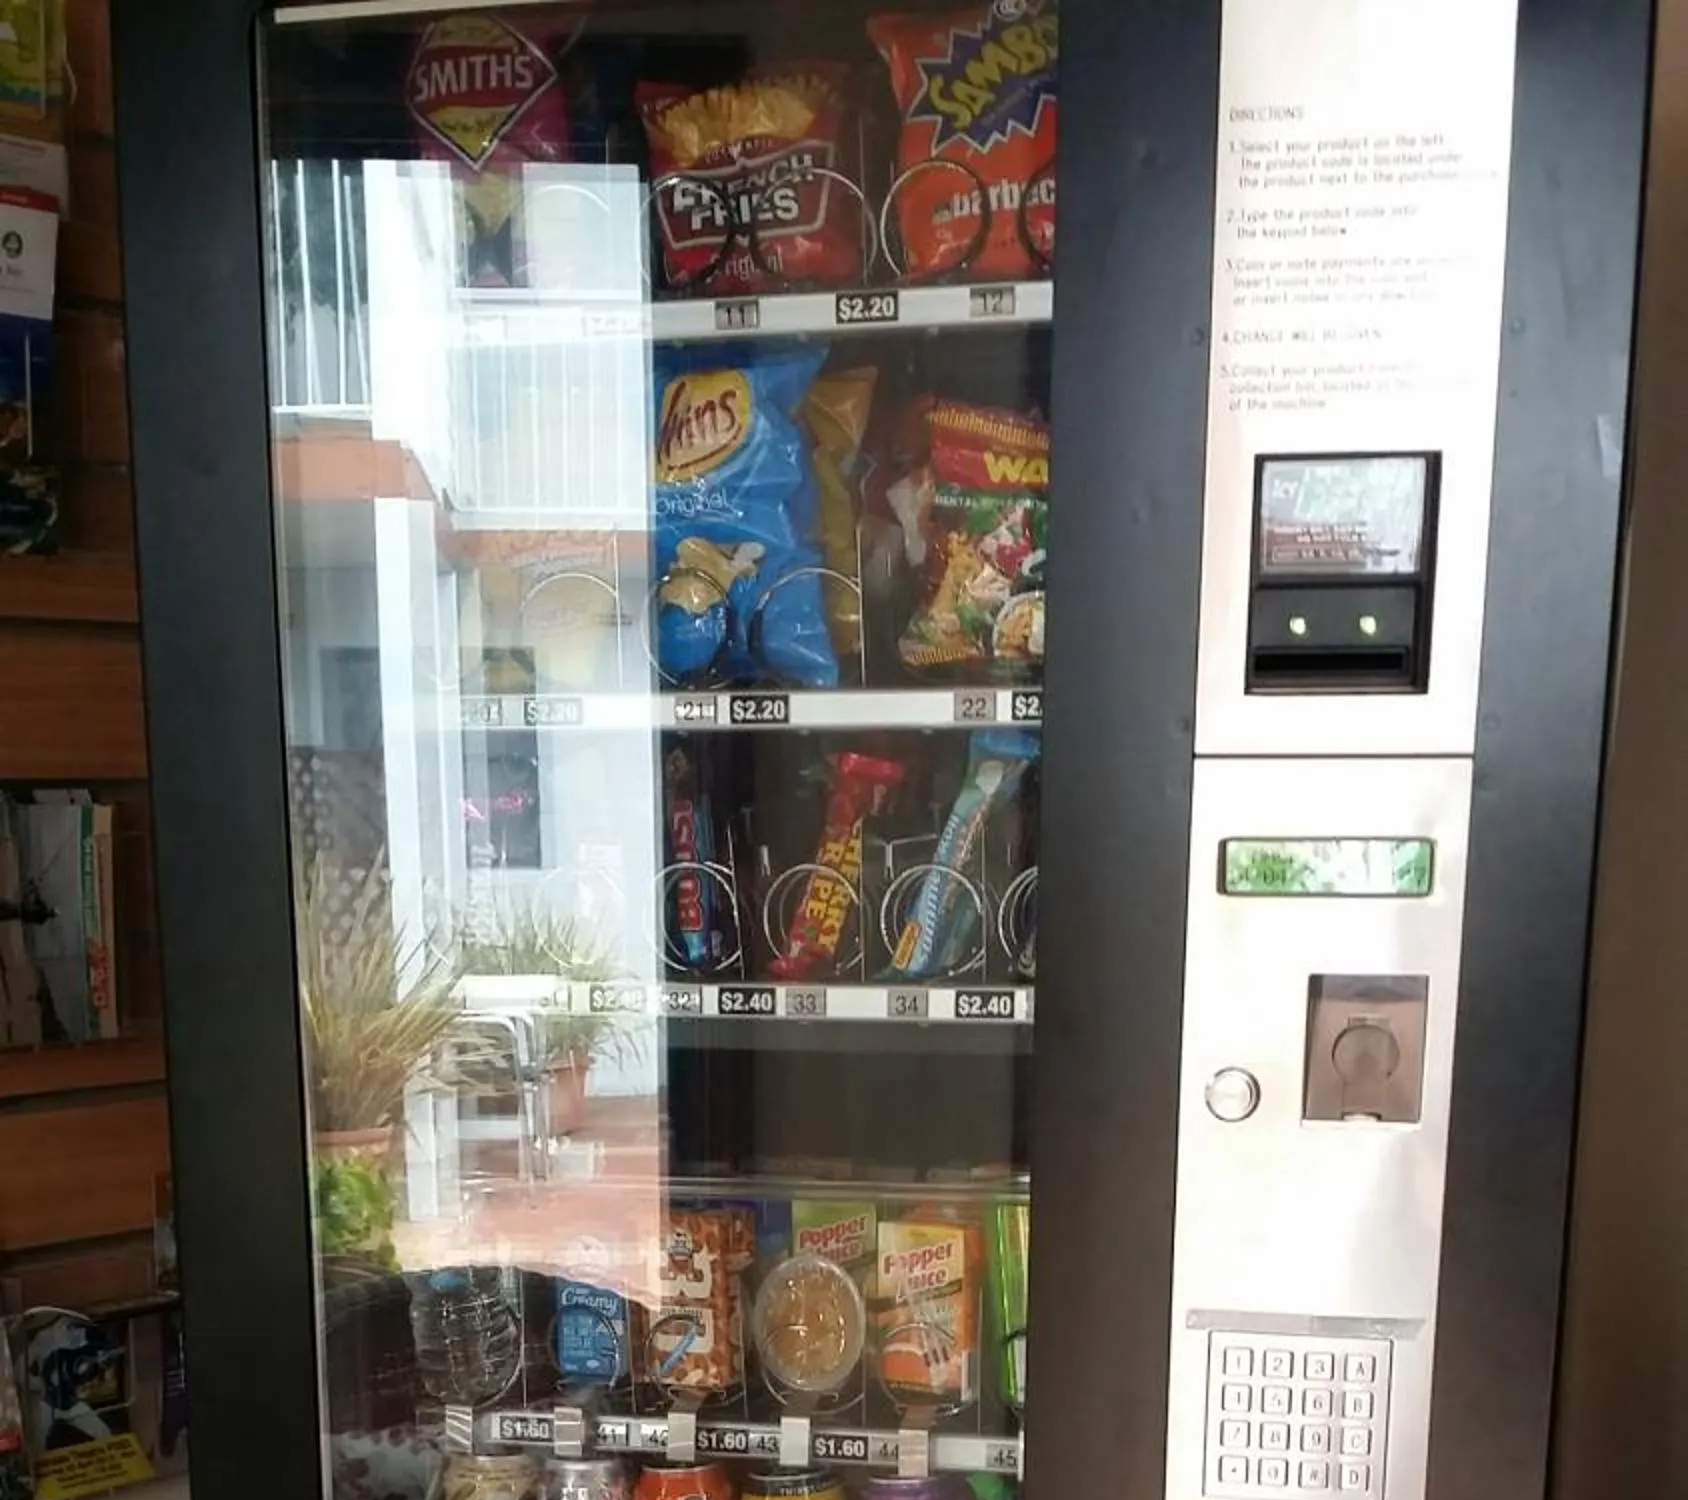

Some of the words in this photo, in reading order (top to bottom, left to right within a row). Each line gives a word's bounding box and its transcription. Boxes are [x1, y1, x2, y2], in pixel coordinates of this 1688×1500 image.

[413, 46, 534, 102] SMITH'S
[838, 300, 895, 320] $2.20
[731, 701, 787, 720] $2.20
[961, 698, 986, 718] 22
[805, 841, 845, 921] RPE
[668, 991, 692, 1011] 32
[720, 990, 773, 1012] $2.40
[894, 994, 918, 1015] 34
[957, 994, 1012, 1017] $2.40
[501, 1419, 550, 1439] $1.60
[697, 1431, 747, 1451] $1.60
[815, 1438, 866, 1458] $1.60
[993, 1449, 1017, 1466] 45
